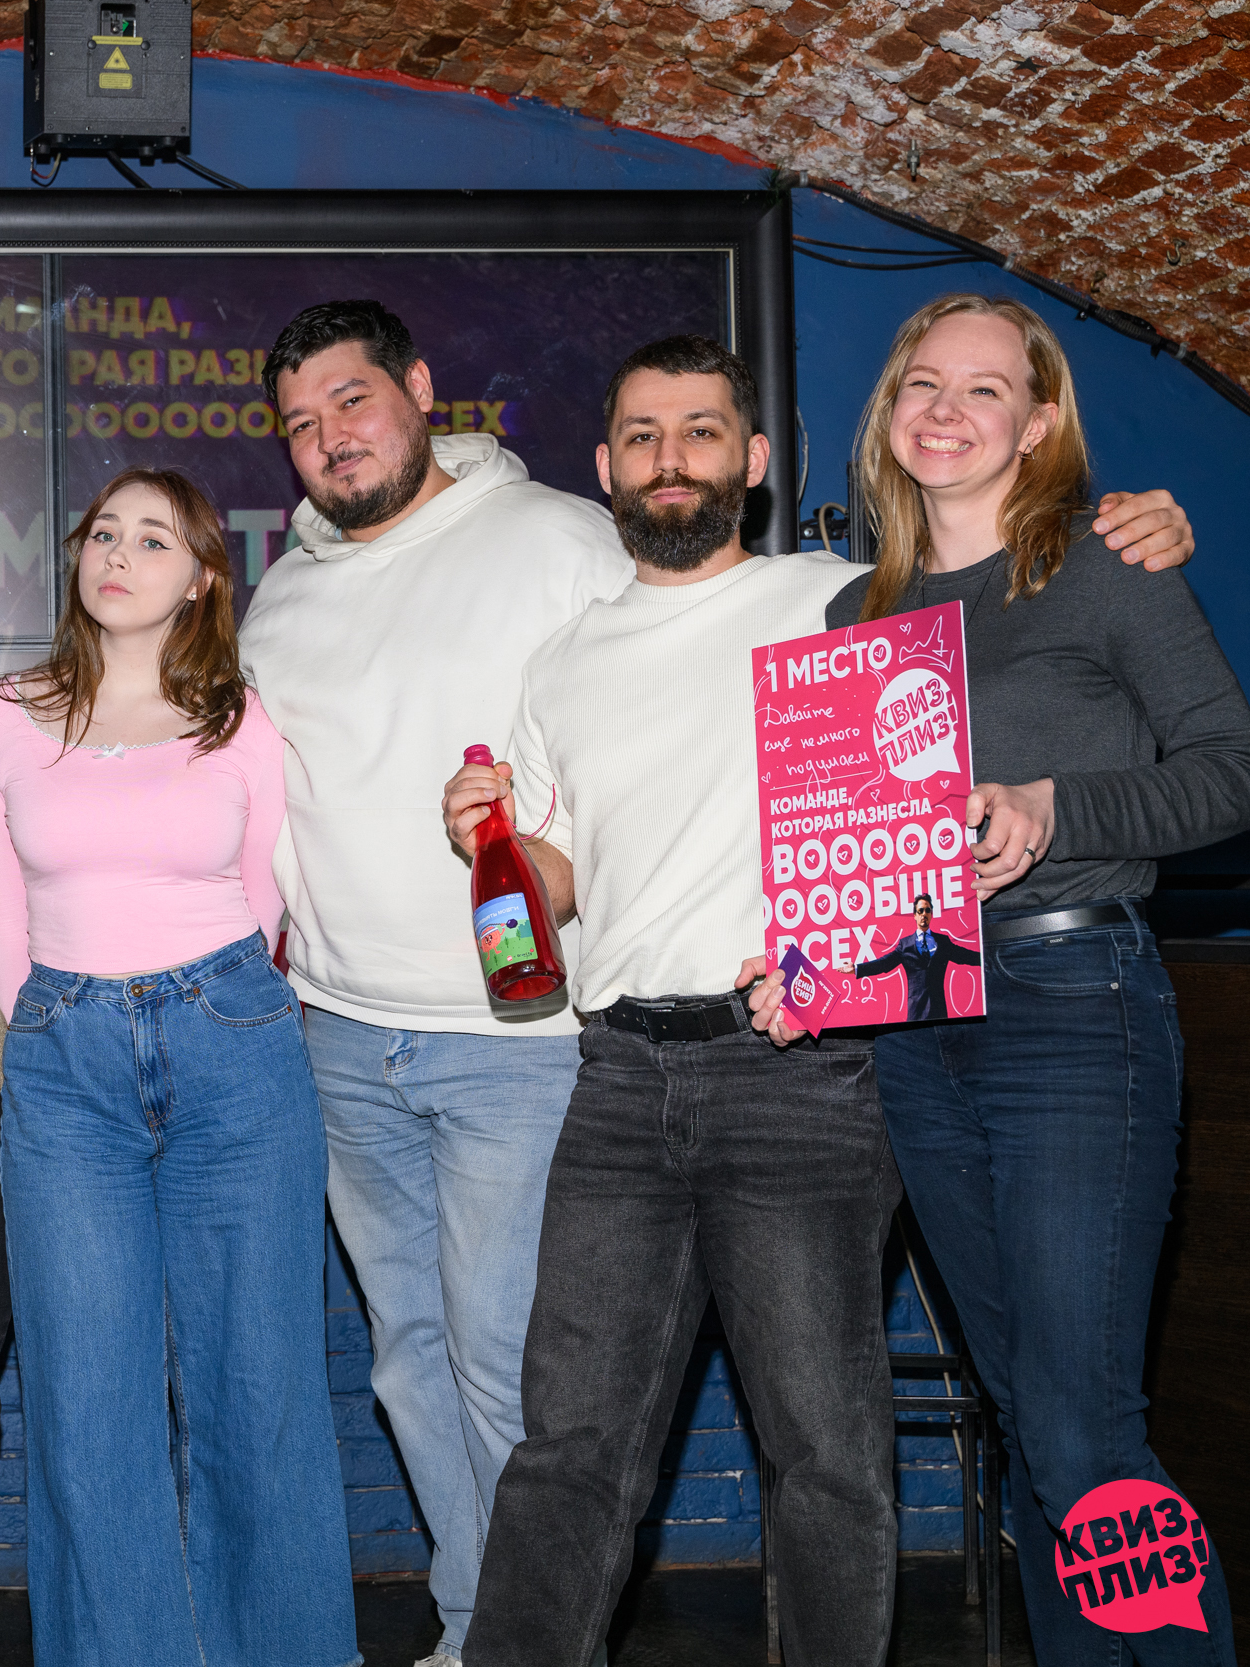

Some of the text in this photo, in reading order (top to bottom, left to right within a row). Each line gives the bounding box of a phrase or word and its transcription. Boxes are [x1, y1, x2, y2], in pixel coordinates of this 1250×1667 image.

[428, 400, 508, 437] СЕХ
[766, 637, 892, 693] 1 МЕСТО
[755, 702, 836, 728] Давайте
[800, 727, 860, 749] немного
[878, 703, 958, 768] ПЛИЗ!
[786, 751, 870, 784] подумаем
[770, 787, 853, 815] КОМАНДЕ,
[771, 798, 933, 839] КОТОРАЯ РАЗНЕСЛА
